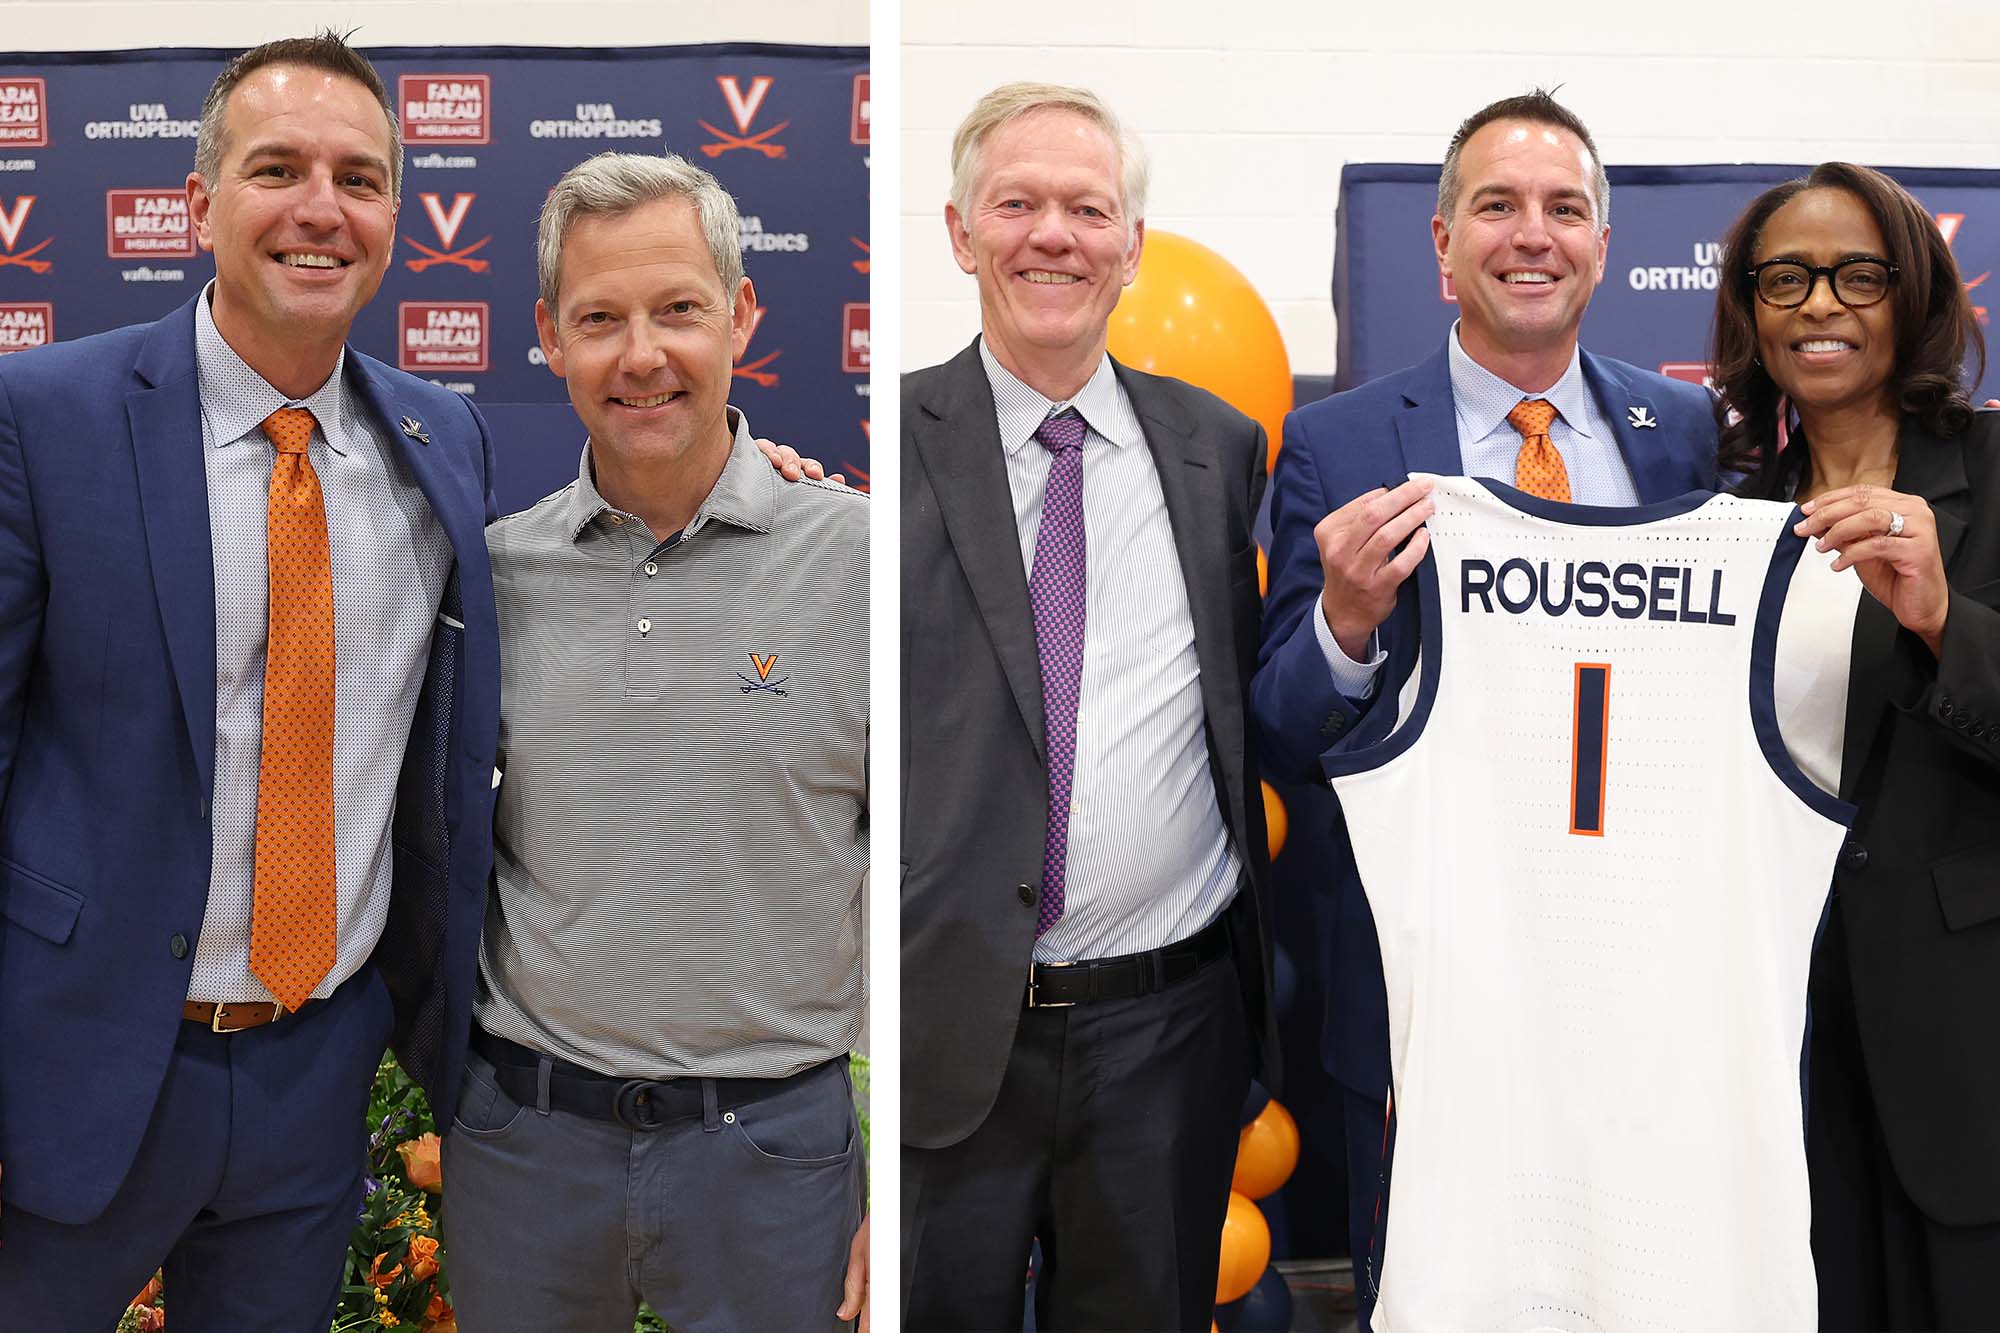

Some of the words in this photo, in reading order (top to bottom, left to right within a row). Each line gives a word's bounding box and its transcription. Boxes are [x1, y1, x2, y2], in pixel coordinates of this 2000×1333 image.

[0, 87, 37, 104] ARM
[427, 83, 481, 100] FARM
[0, 104, 39, 122] EAU
[129, 104, 168, 121] UVA
[406, 101, 481, 120] BUREAU
[576, 104, 616, 121] UVA
[717, 75, 773, 134] V
[84, 120, 201, 139] ORTHOPEDIC
[530, 119, 662, 138] ORTHOPEDICS
[134, 198, 188, 215] FARM
[114, 216, 188, 233] BUREAU
[418, 192, 477, 251] V
[739, 233, 808, 252] PEDICS
[427, 311, 480, 328] FARM
[406, 328, 480, 347] BUREAU
[1461, 558, 1736, 626] ROUSSELL
[748, 653, 779, 683] V
[1569, 663, 1612, 837] 1
